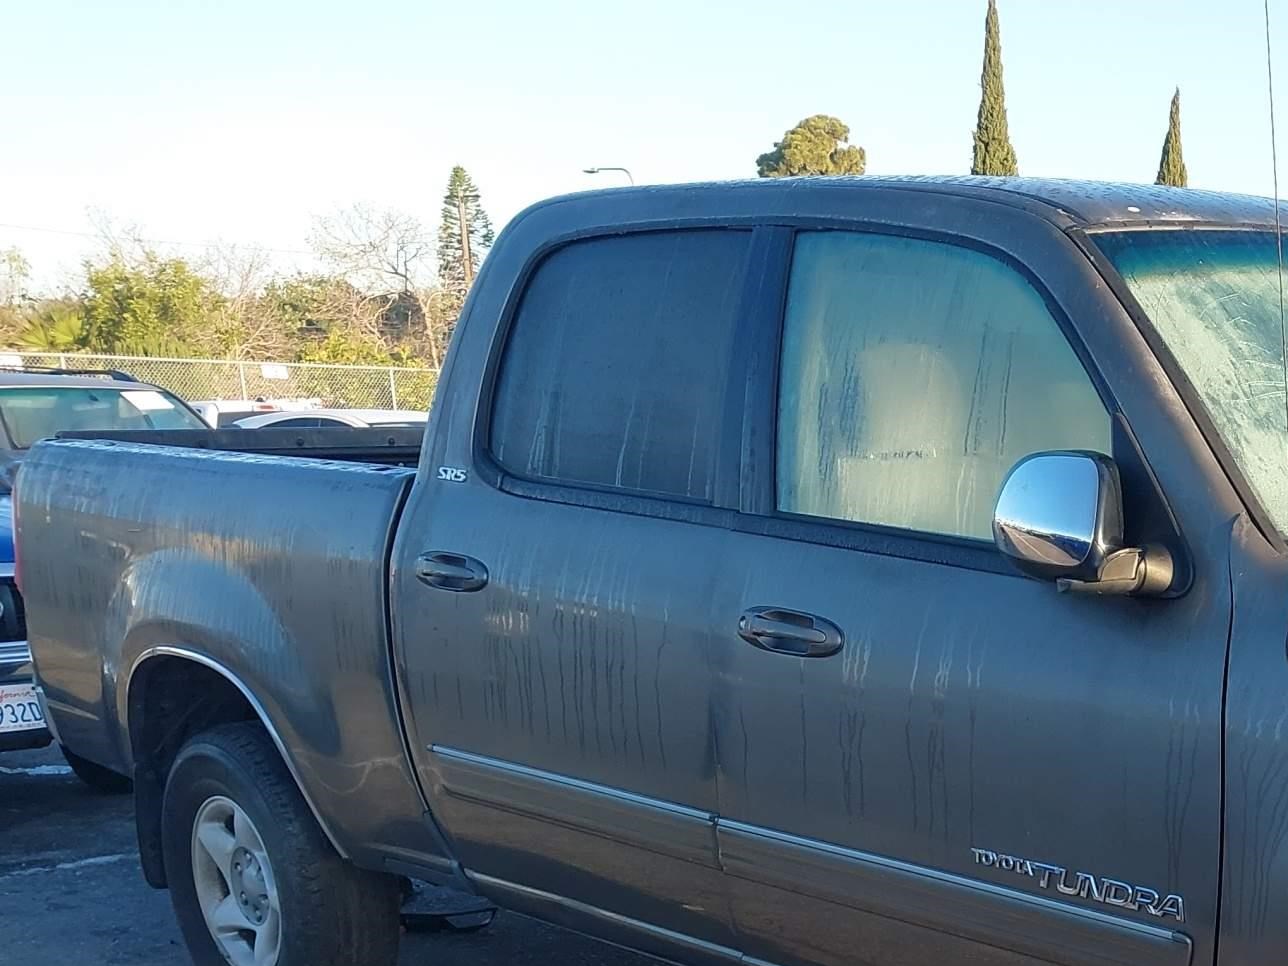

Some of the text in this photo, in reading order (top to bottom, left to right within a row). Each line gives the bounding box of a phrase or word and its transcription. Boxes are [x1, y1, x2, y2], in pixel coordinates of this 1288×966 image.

[437, 466, 467, 482] SR5
[0, 702, 44, 725] 32D
[971, 847, 1185, 922] TOYOTA TUNDRA
